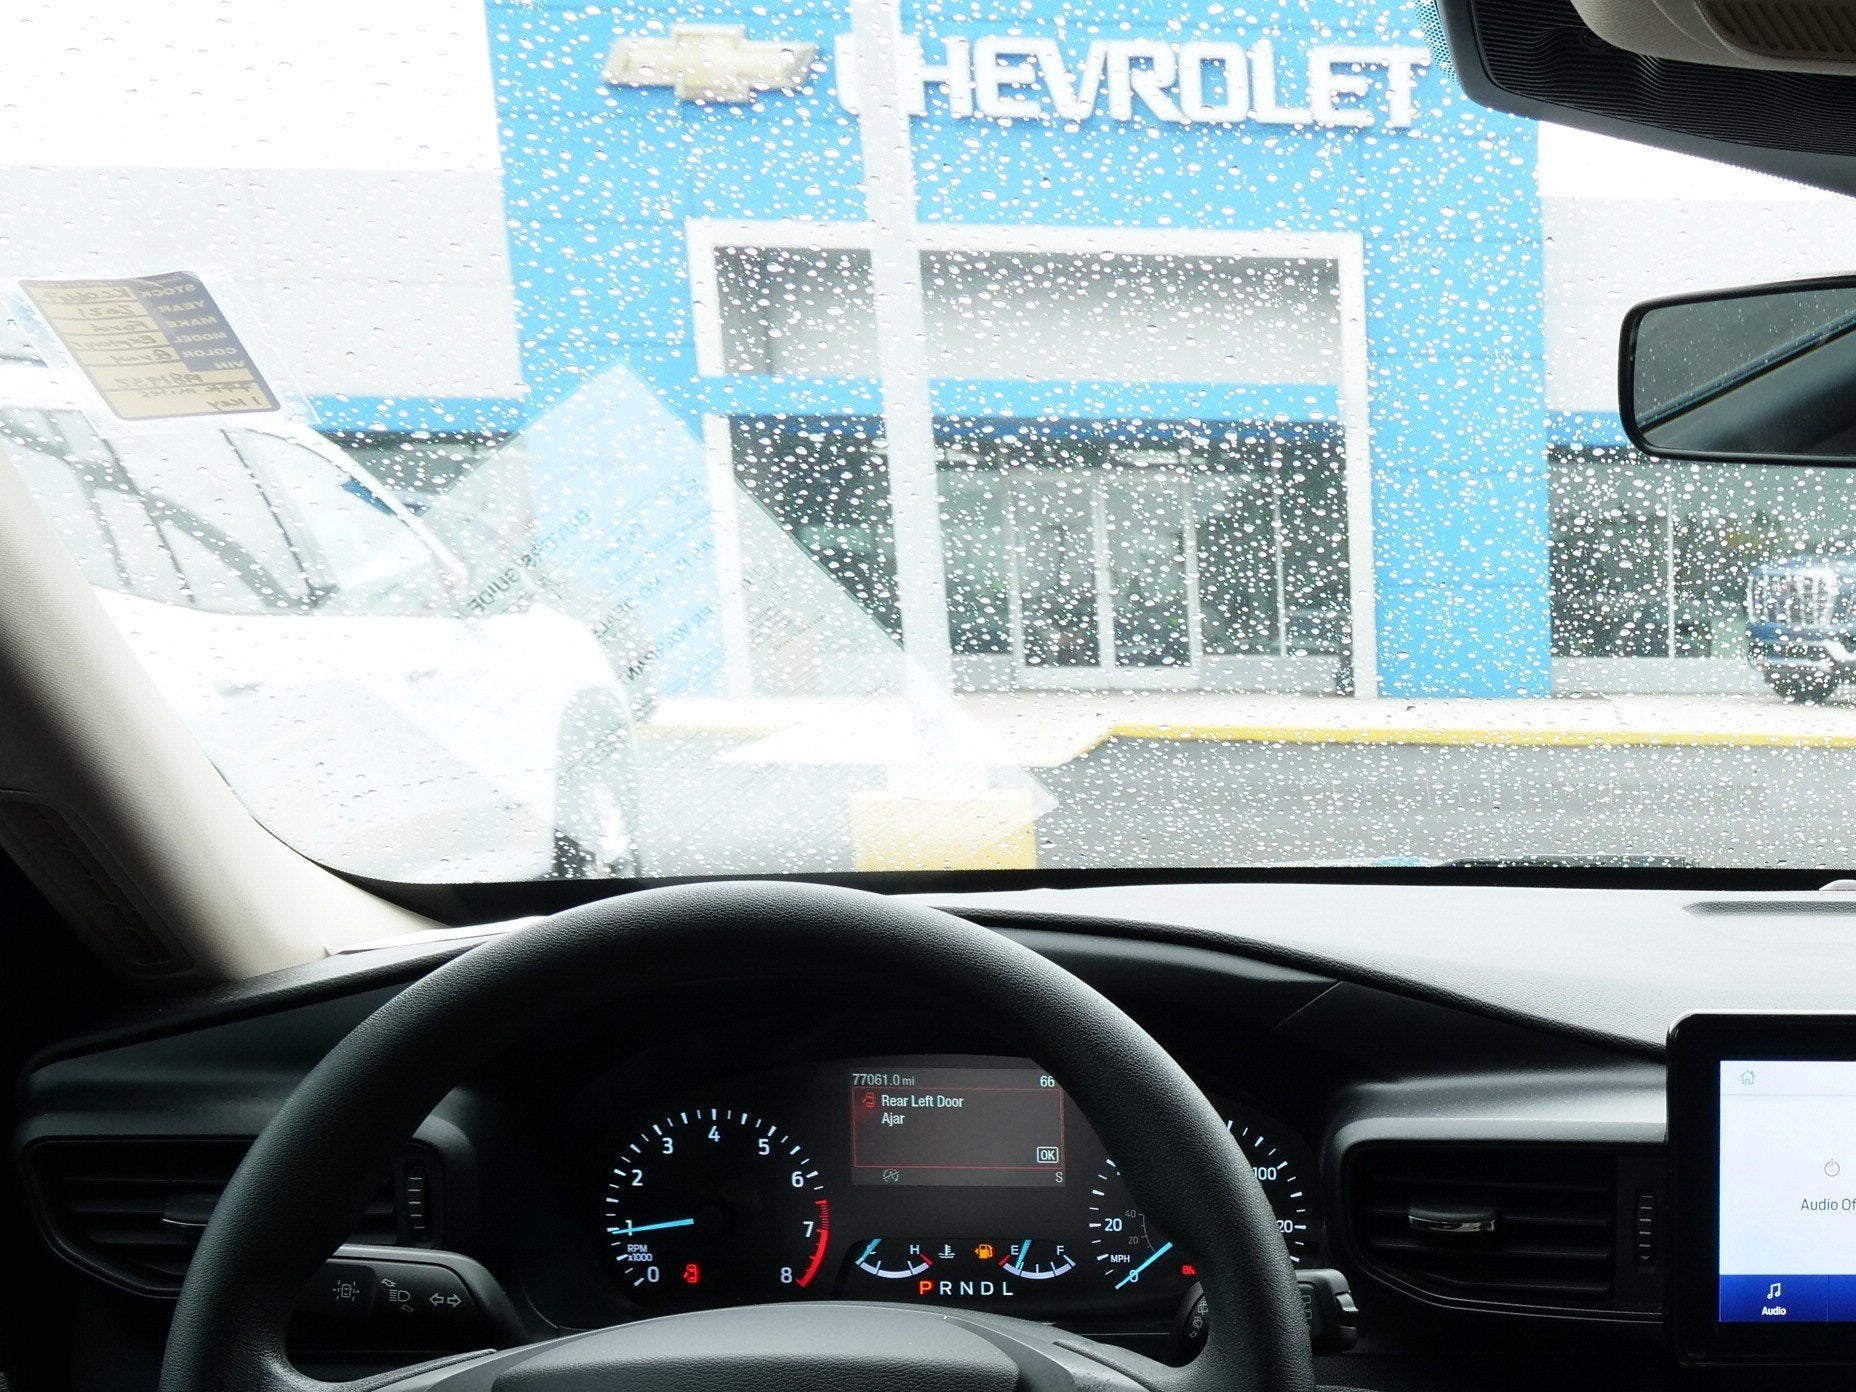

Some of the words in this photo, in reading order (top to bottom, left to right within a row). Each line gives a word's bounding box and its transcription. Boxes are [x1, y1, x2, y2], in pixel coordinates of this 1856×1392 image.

[852, 1073, 902, 1087] 77061.0
[903, 1075, 915, 1086] mi
[881, 1094, 909, 1108] Rear
[911, 1094, 934, 1108] Left
[937, 1094, 964, 1108] Door
[881, 1111, 906, 1126] Ajar
[708, 1126, 721, 1142] 4
[662, 1138, 674, 1155] 3
[758, 1139, 770, 1155] 5
[1040, 1149, 1056, 1162] OK
[631, 1170, 643, 1186] 2
[791, 1172, 804, 1188] 6
[1055, 1171, 1063, 1184] S
[1800, 1198, 1839, 1211] Audio
[803, 1221, 814, 1237] 7
[1104, 1218, 1122, 1232] 20
[1278, 1219, 1293, 1233] 20
[627, 1244, 648, 1254] RPM
[909, 1245, 920, 1255] H
[1010, 1245, 1019, 1256] E
[1057, 1245, 1065, 1256] F
[628, 1253, 653, 1263] x1000
[1110, 1254, 1130, 1263] MPH
[647, 1267, 660, 1283] 0
[780, 1267, 792, 1283] 8
[920, 1282, 932, 1294] P
[940, 1282, 952, 1295] R
[961, 1282, 974, 1295] N
[981, 1282, 994, 1295] D
[1003, 1282, 1013, 1295] L
[1761, 1305, 1787, 1316] Audio
